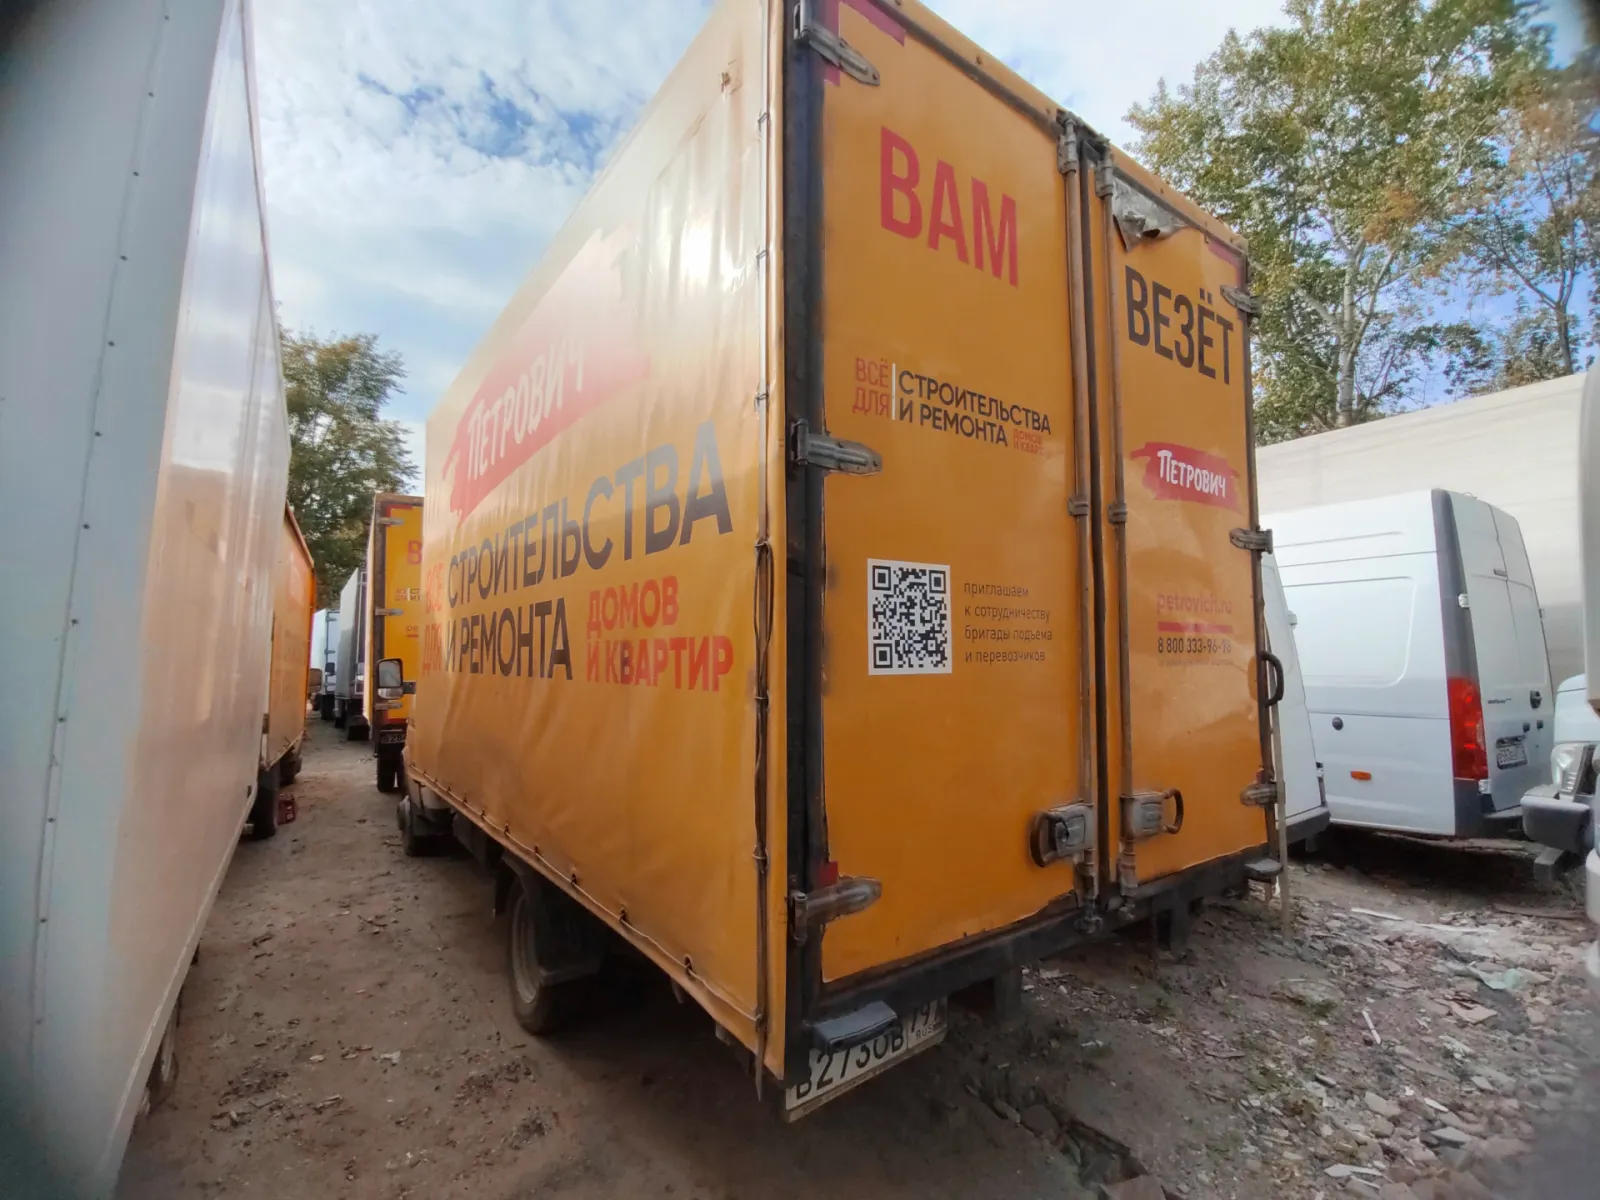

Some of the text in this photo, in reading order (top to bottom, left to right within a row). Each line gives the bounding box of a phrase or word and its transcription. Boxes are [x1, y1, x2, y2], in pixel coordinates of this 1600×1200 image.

[881, 125, 1018, 288] ВАМ
[1125, 265, 1233, 385] ВЕЗЁТ
[856, 357, 888, 388] ВСЁ
[852, 387, 890, 417] ДЛЯ
[899, 370, 1051, 435] СТРОИТЕЛЬСТВА
[900, 398, 1008, 446] И РЕМОНТА
[1157, 450, 1226, 498] ПЕТРОВИЧ
[448, 420, 733, 609] СТРОИТЕЛЬСТВА
[586, 575, 679, 639] ДОМОВ
[964, 582, 1029, 597] приглашаем
[446, 597, 573, 680] И РЕМОНТА
[965, 606, 1051, 623] к сотрудничеству
[965, 625, 1010, 643] бригады
[605, 635, 734, 692] КВАРТИР
[965, 651, 1045, 666] и перевозчиков
[1158, 637, 1164, 654] 8
[1166, 637, 1184, 654] 800
